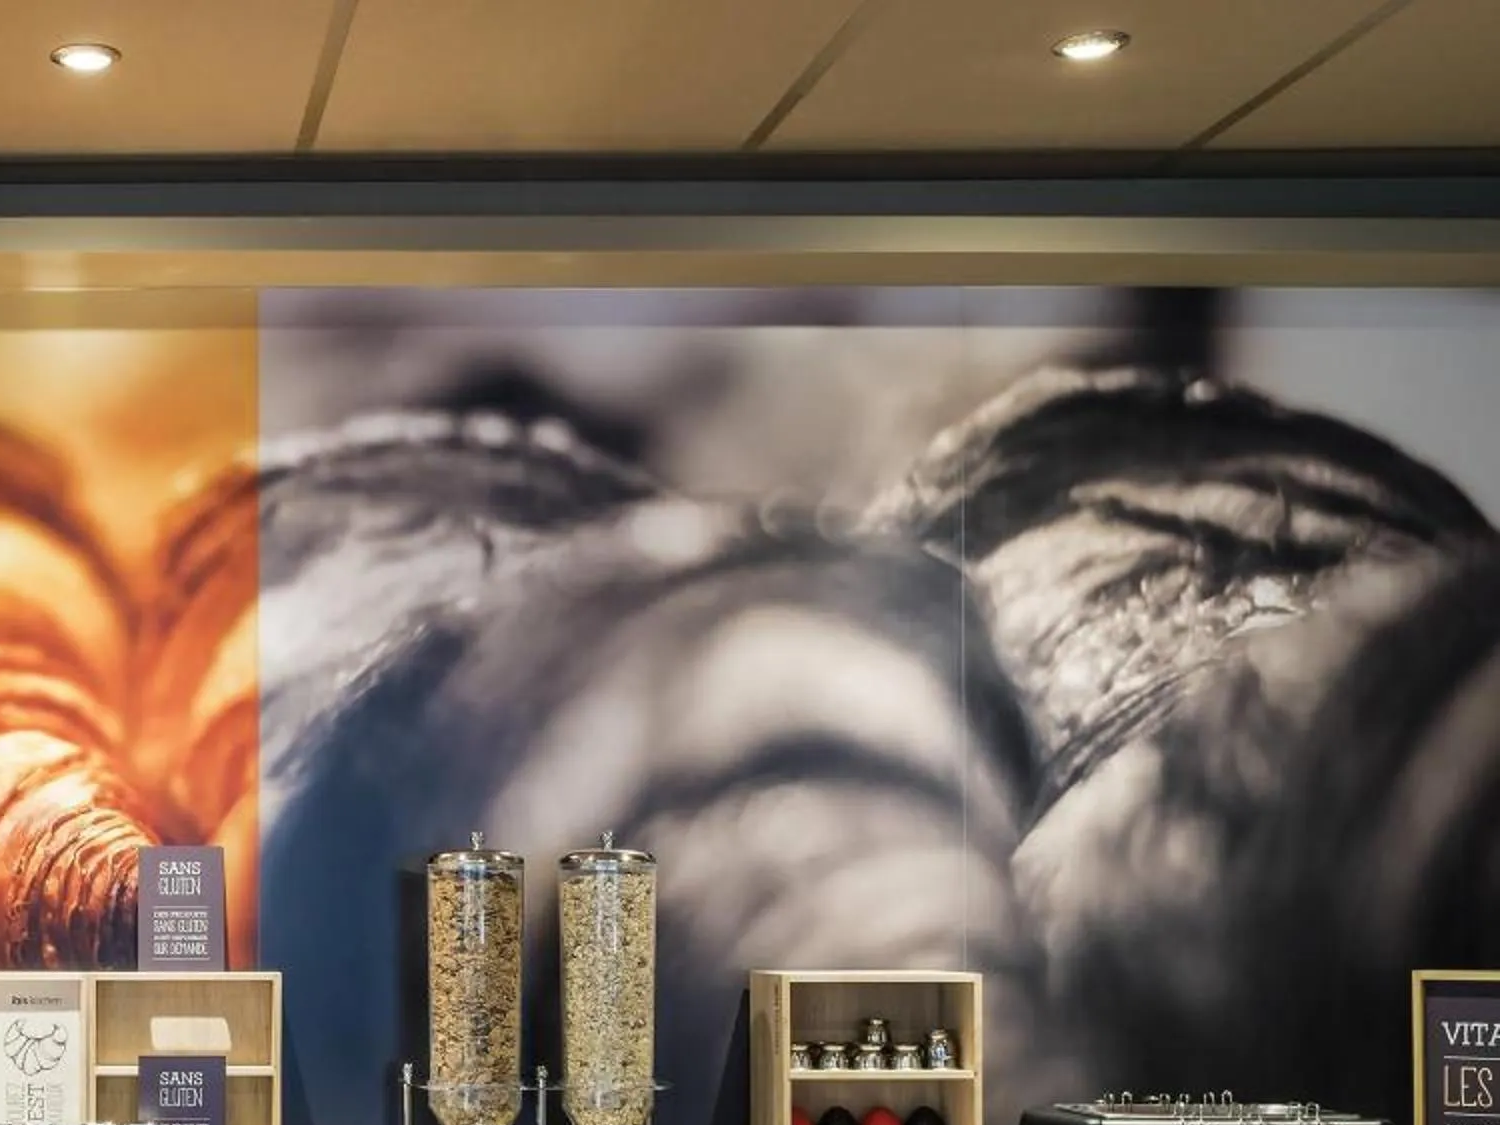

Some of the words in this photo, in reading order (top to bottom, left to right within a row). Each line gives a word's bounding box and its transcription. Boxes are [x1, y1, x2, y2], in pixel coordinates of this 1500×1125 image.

[159, 861, 202, 875] SANS
[159, 877, 202, 895] GLUTEN
[159, 1071, 203, 1085] SANS
[1443, 1065, 1493, 1108] LES
[159, 1087, 203, 1107] GLUTEN
